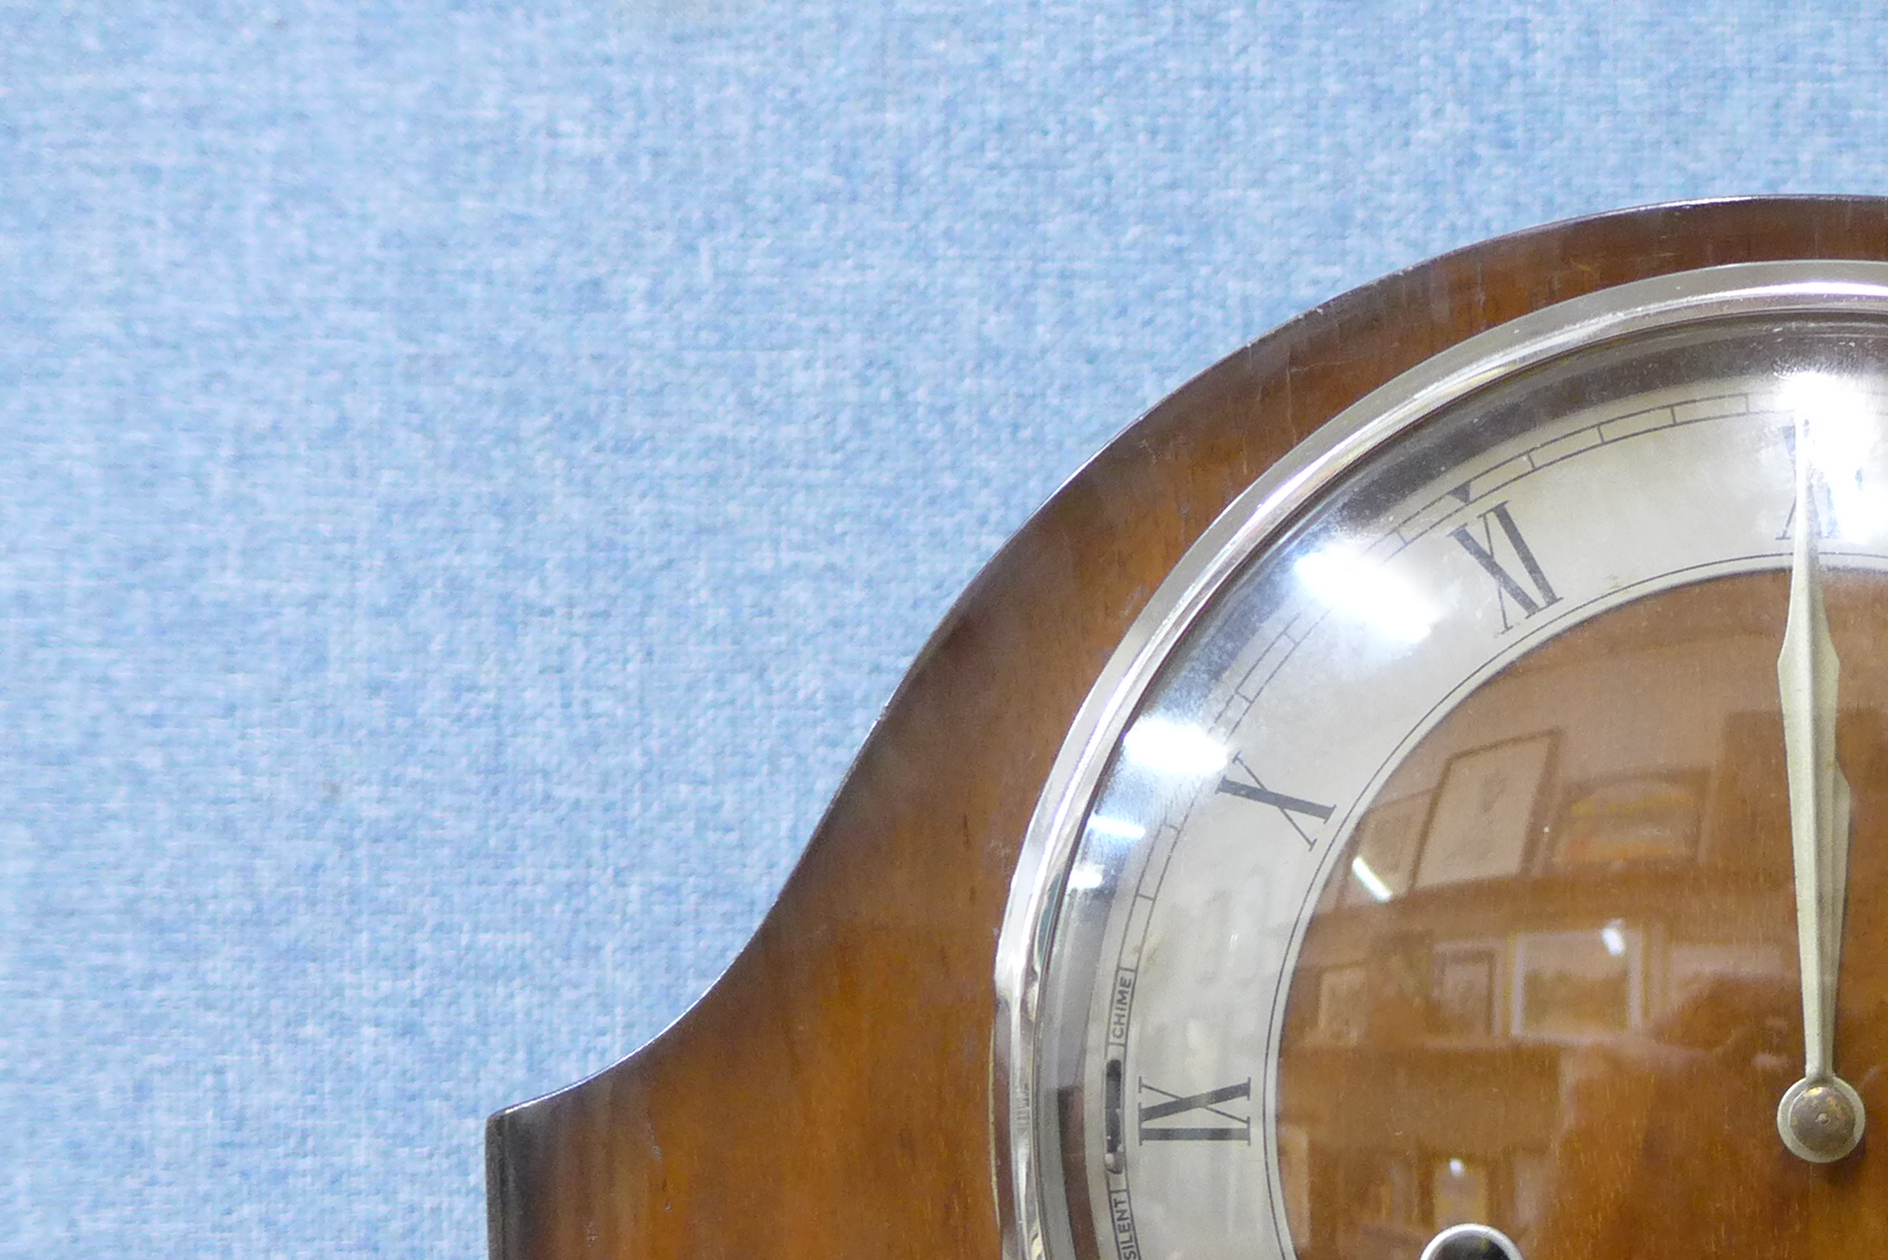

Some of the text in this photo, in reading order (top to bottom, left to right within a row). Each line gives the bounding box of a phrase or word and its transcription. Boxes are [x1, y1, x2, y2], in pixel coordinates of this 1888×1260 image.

[1446, 500, 1564, 634] XI
[1214, 750, 1337, 852] X
[1111, 976, 1133, 1039] CHIME
[1138, 1076, 1251, 1146] IX
